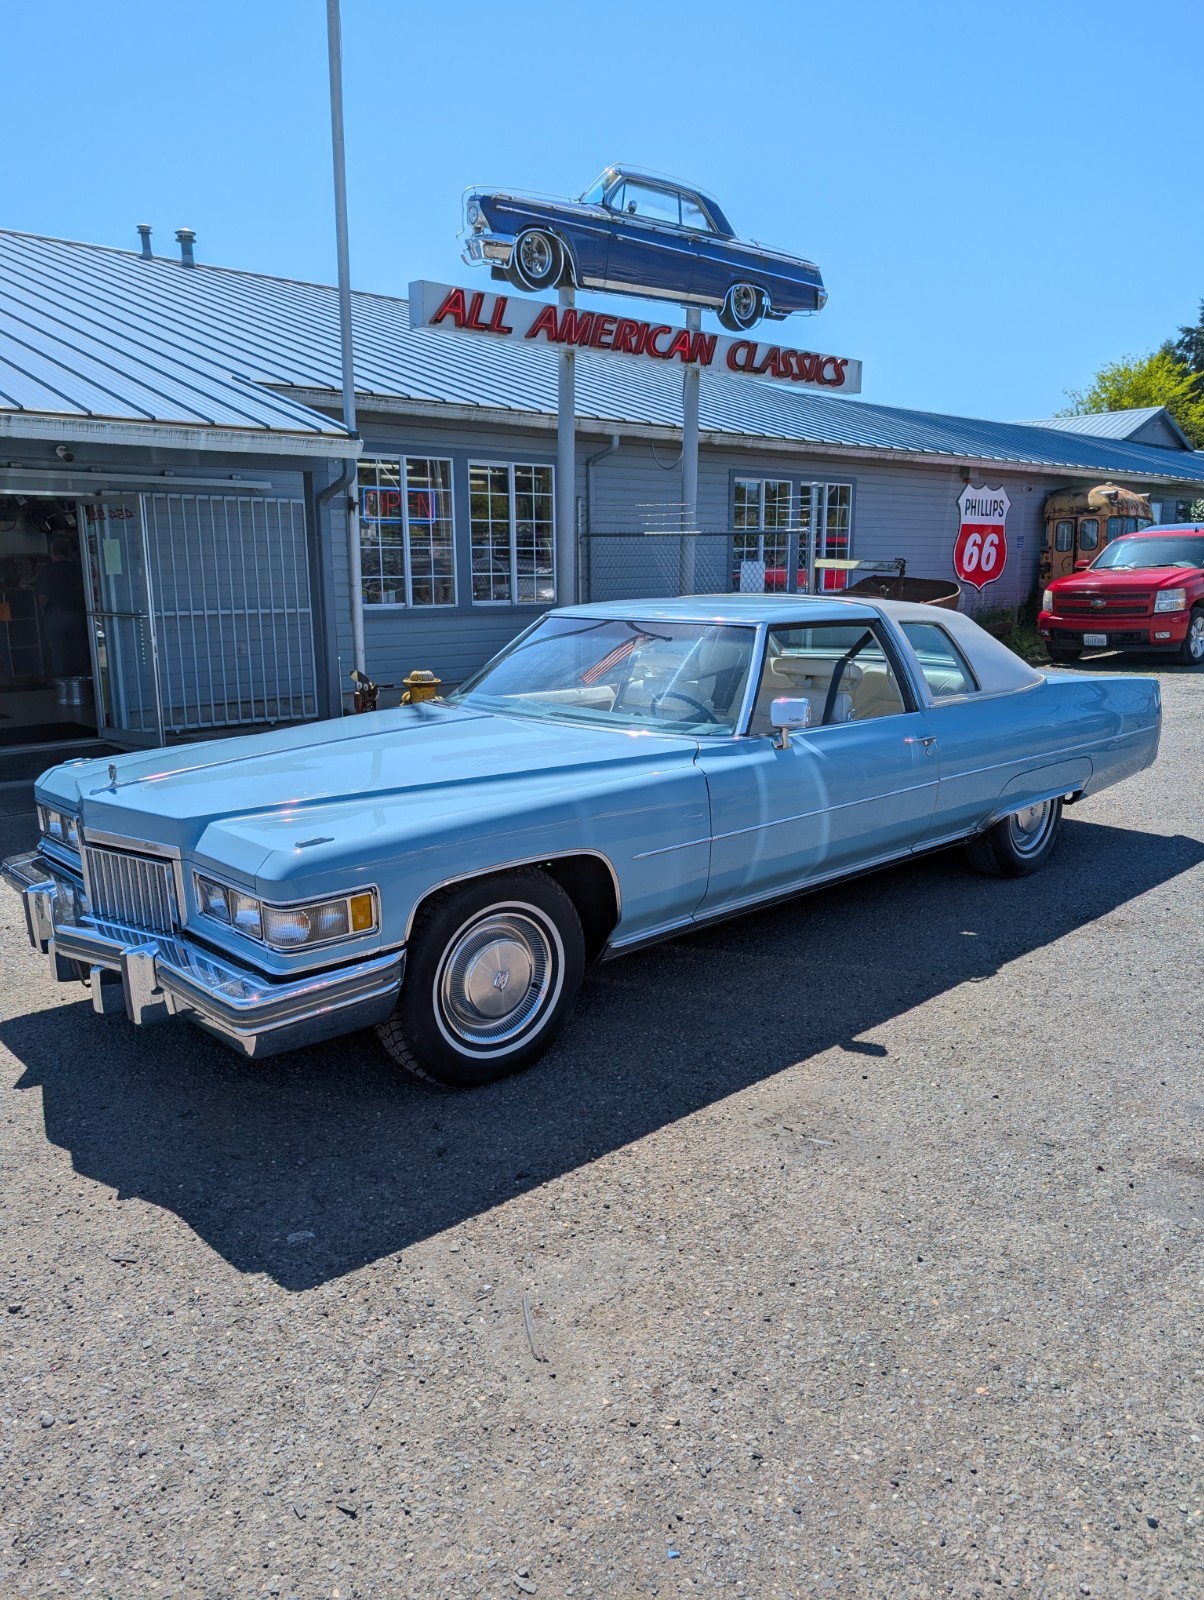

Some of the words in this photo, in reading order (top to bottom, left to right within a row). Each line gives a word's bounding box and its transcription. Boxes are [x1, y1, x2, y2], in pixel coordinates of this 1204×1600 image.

[429, 288, 513, 335] ALL
[525, 305, 718, 365] AMERICAN
[726, 340, 849, 387] CLASSICS
[964, 498, 1005, 518] PHILLIPS
[963, 533, 999, 572] 66
